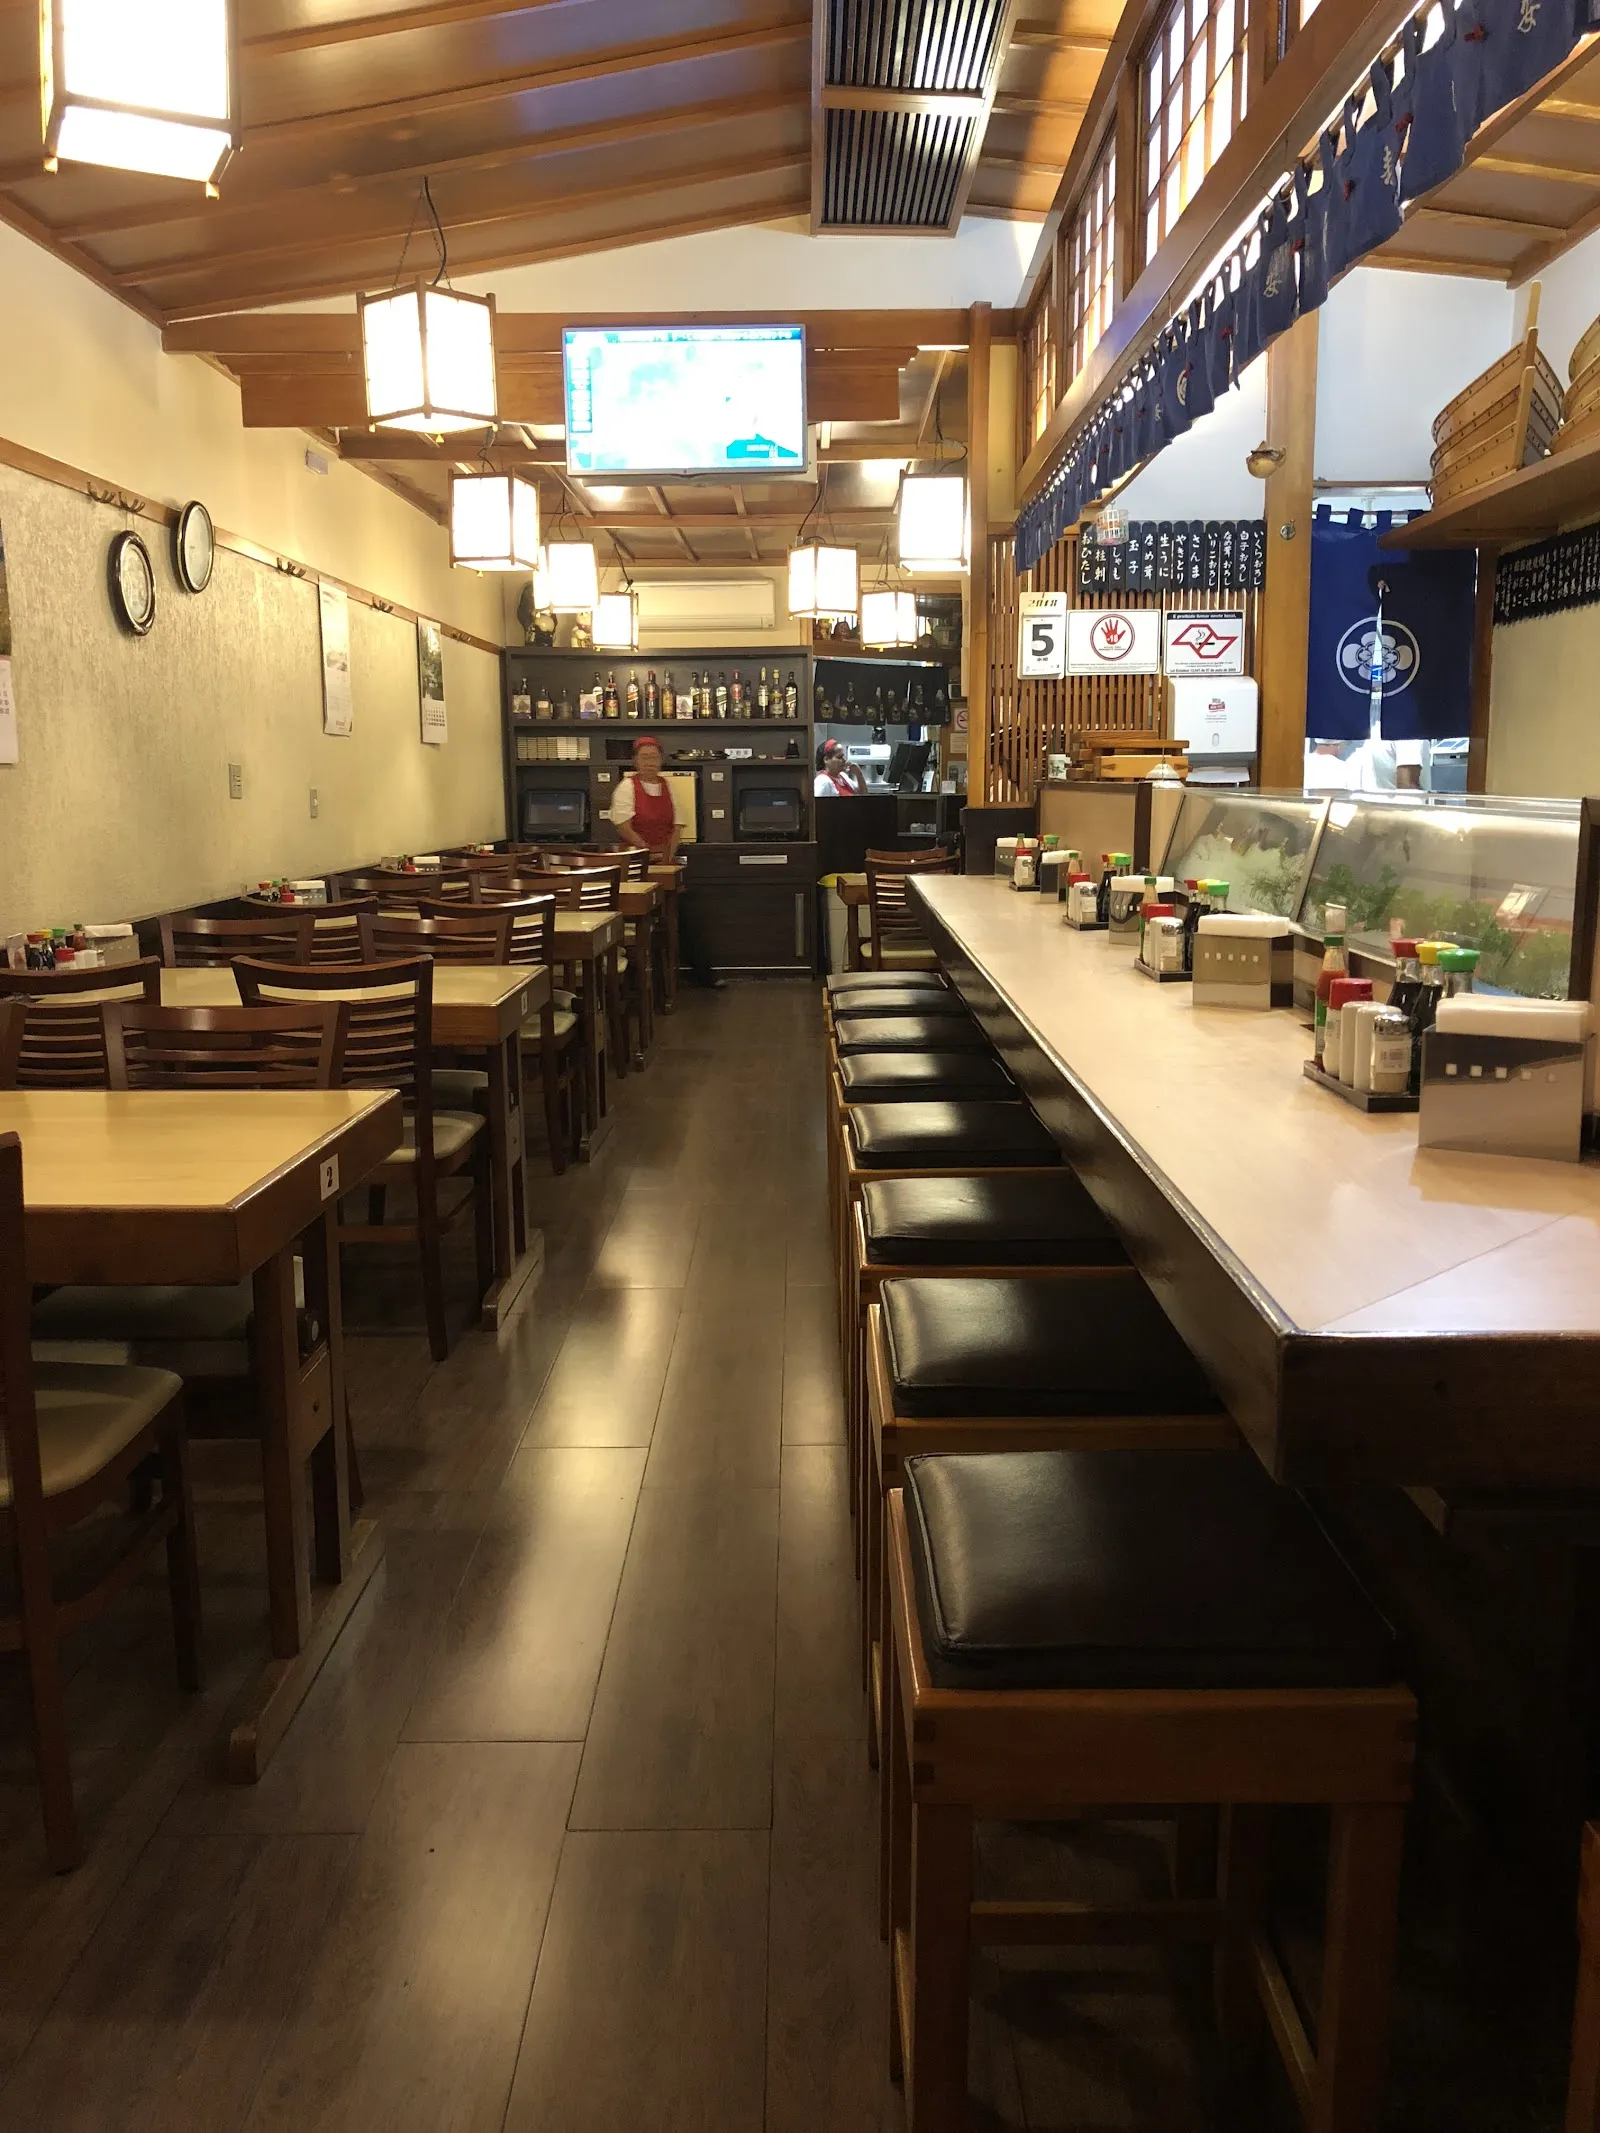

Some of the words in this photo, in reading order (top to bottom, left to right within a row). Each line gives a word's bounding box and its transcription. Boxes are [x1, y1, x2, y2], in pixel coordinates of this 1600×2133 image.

[1080, 532, 1093, 585] おひたし
[1128, 539, 1139, 575] 玉子
[1143, 533, 1155, 580] なめ茸
[1159, 532, 1170, 577] 生うに
[1175, 534, 1187, 585] やきとり
[1190, 534, 1201, 579] さんま
[1207, 532, 1218, 587] いりこおろし
[1238, 530, 1250, 582] 白子おろし
[1253, 531, 1264, 585] いくらおろし
[1031, 623, 1054, 657] 5
[326, 1166, 334, 1189] 2
